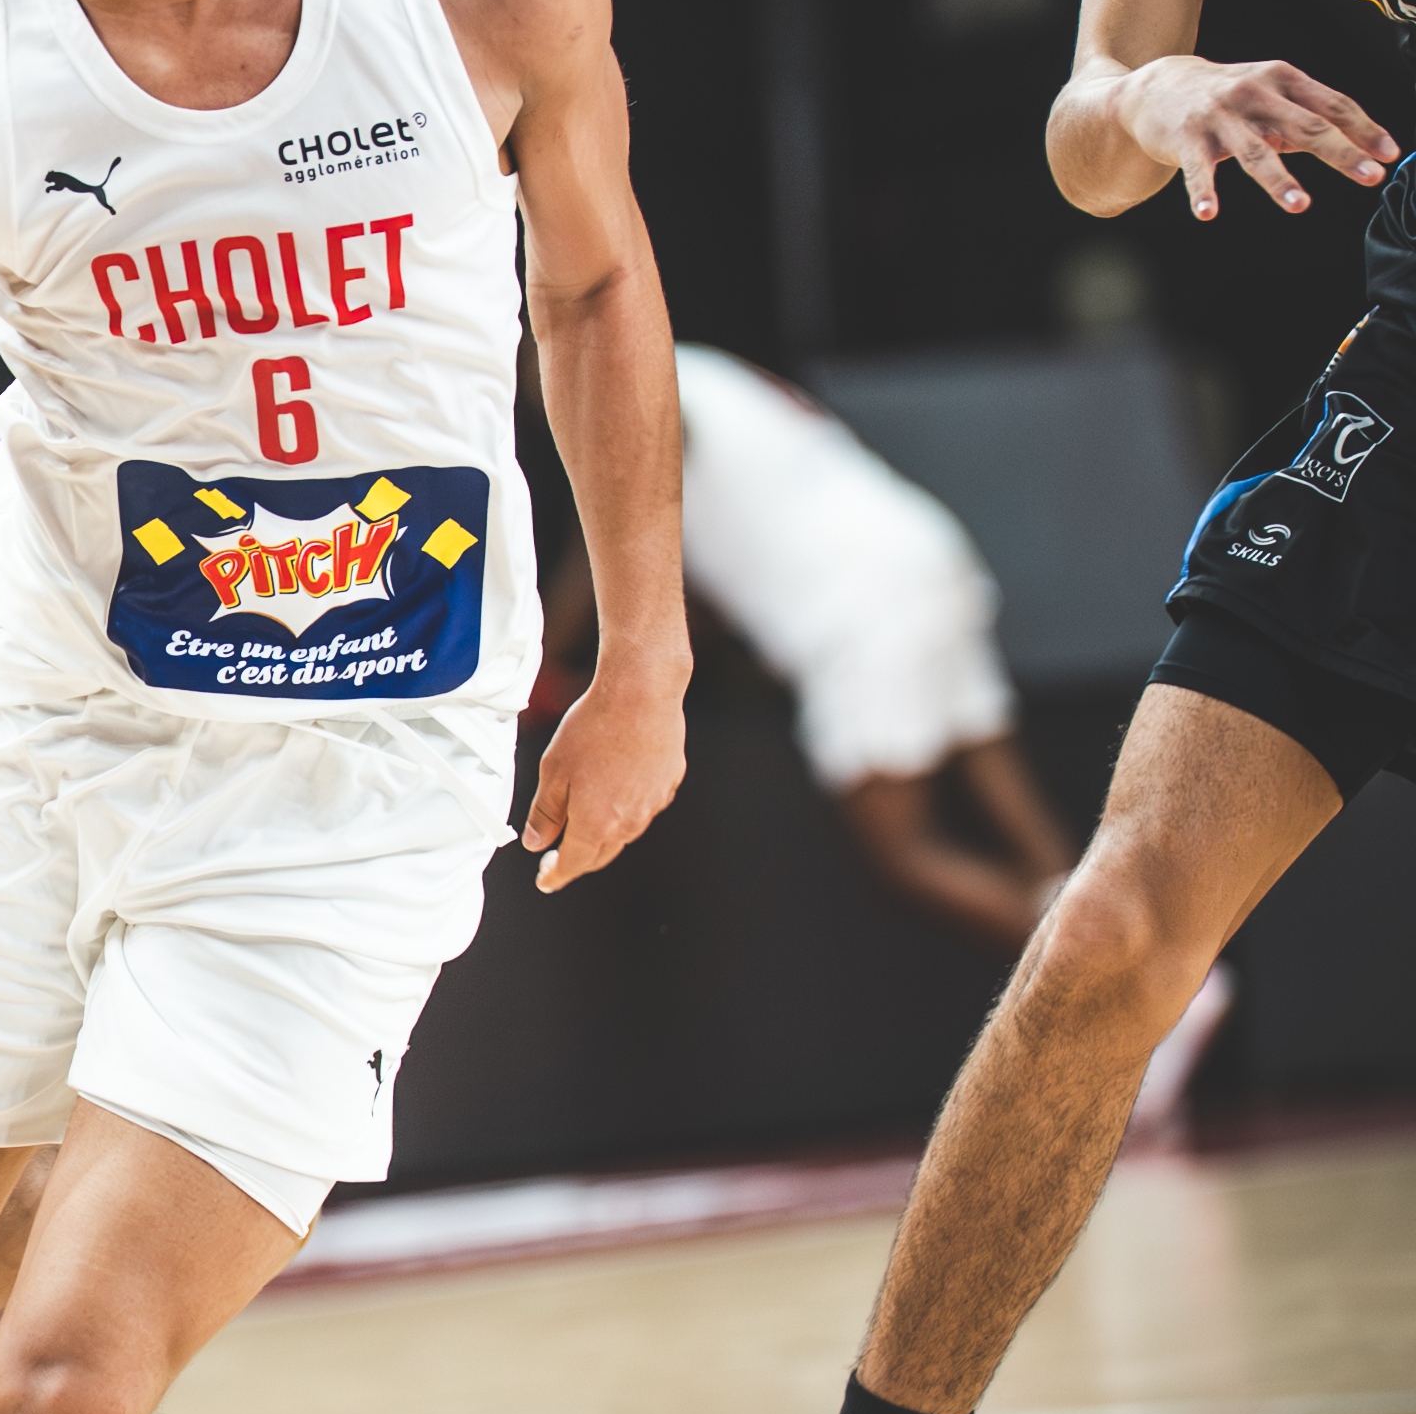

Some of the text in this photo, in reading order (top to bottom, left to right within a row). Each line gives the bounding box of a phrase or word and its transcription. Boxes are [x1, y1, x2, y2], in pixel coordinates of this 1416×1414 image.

[283, 147, 420, 184] agglomération
[91, 213, 414, 345] CHOLET
[252, 355, 319, 465] 6
[1227, 542, 1283, 567] SKILLS
[165, 626, 398, 664] Etre un enfant
[216, 648, 428, 686] c'est du sport
